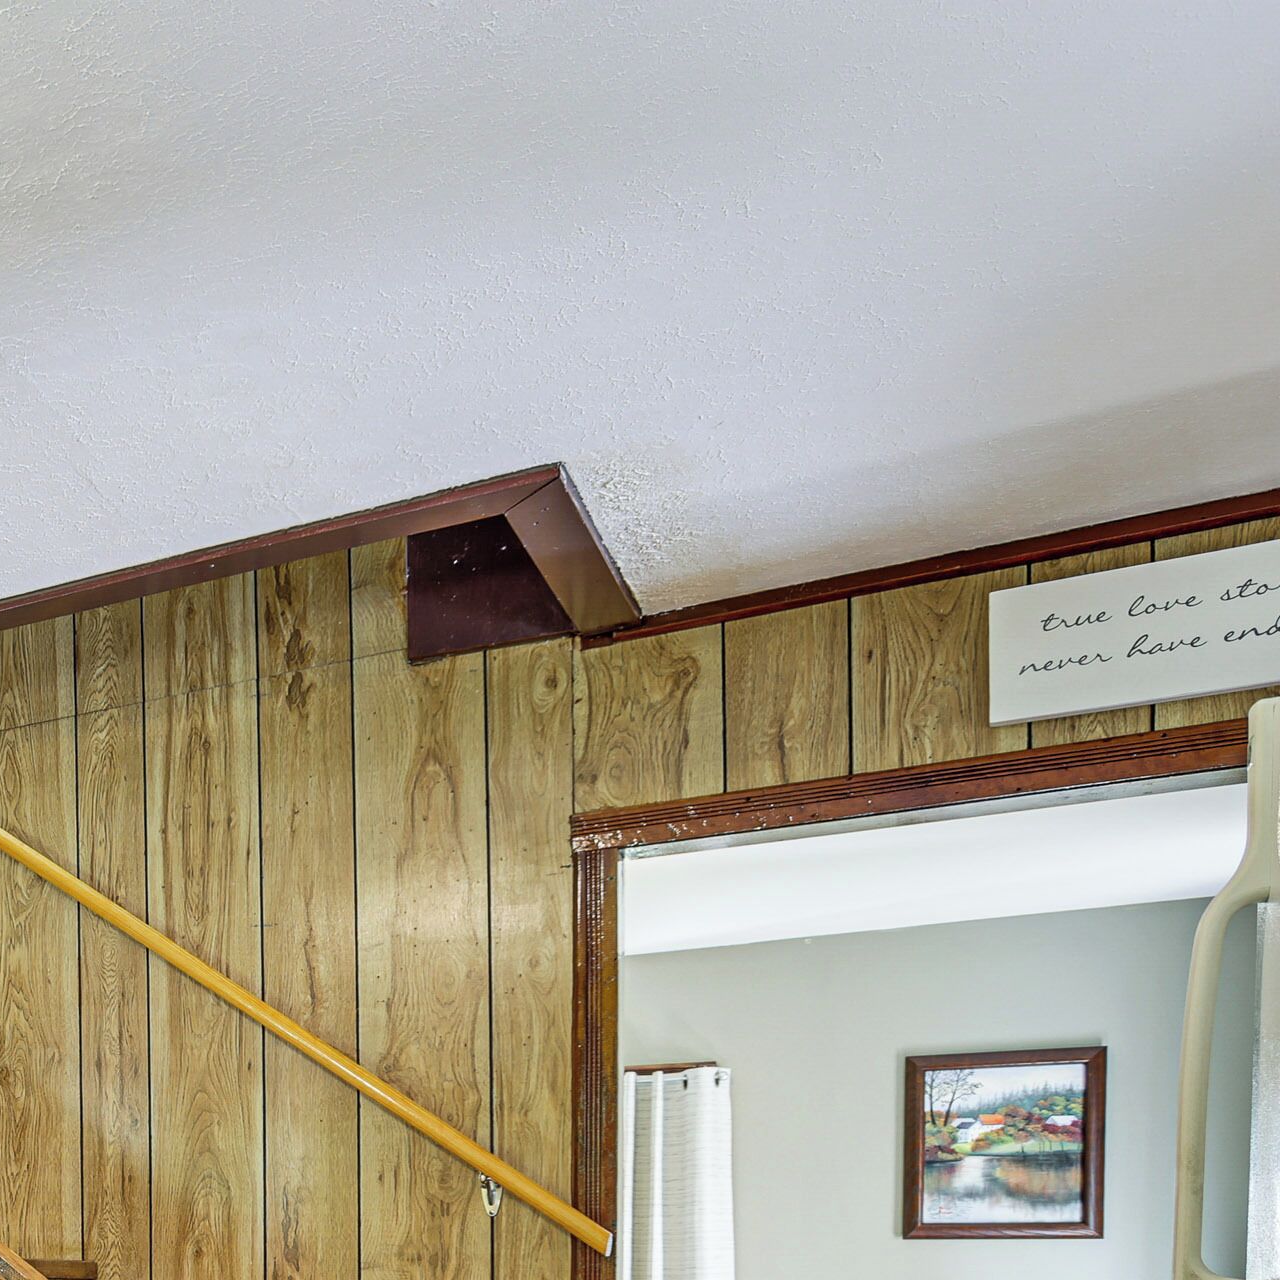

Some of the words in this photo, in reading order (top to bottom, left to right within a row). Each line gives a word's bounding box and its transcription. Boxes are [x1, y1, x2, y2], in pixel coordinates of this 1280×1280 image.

[1040, 610, 1113, 633] true
[1127, 595, 1203, 618] love
[1219, 578, 1280, 601] sto
[1018, 651, 1113, 676] never
[1126, 634, 1207, 658] have
